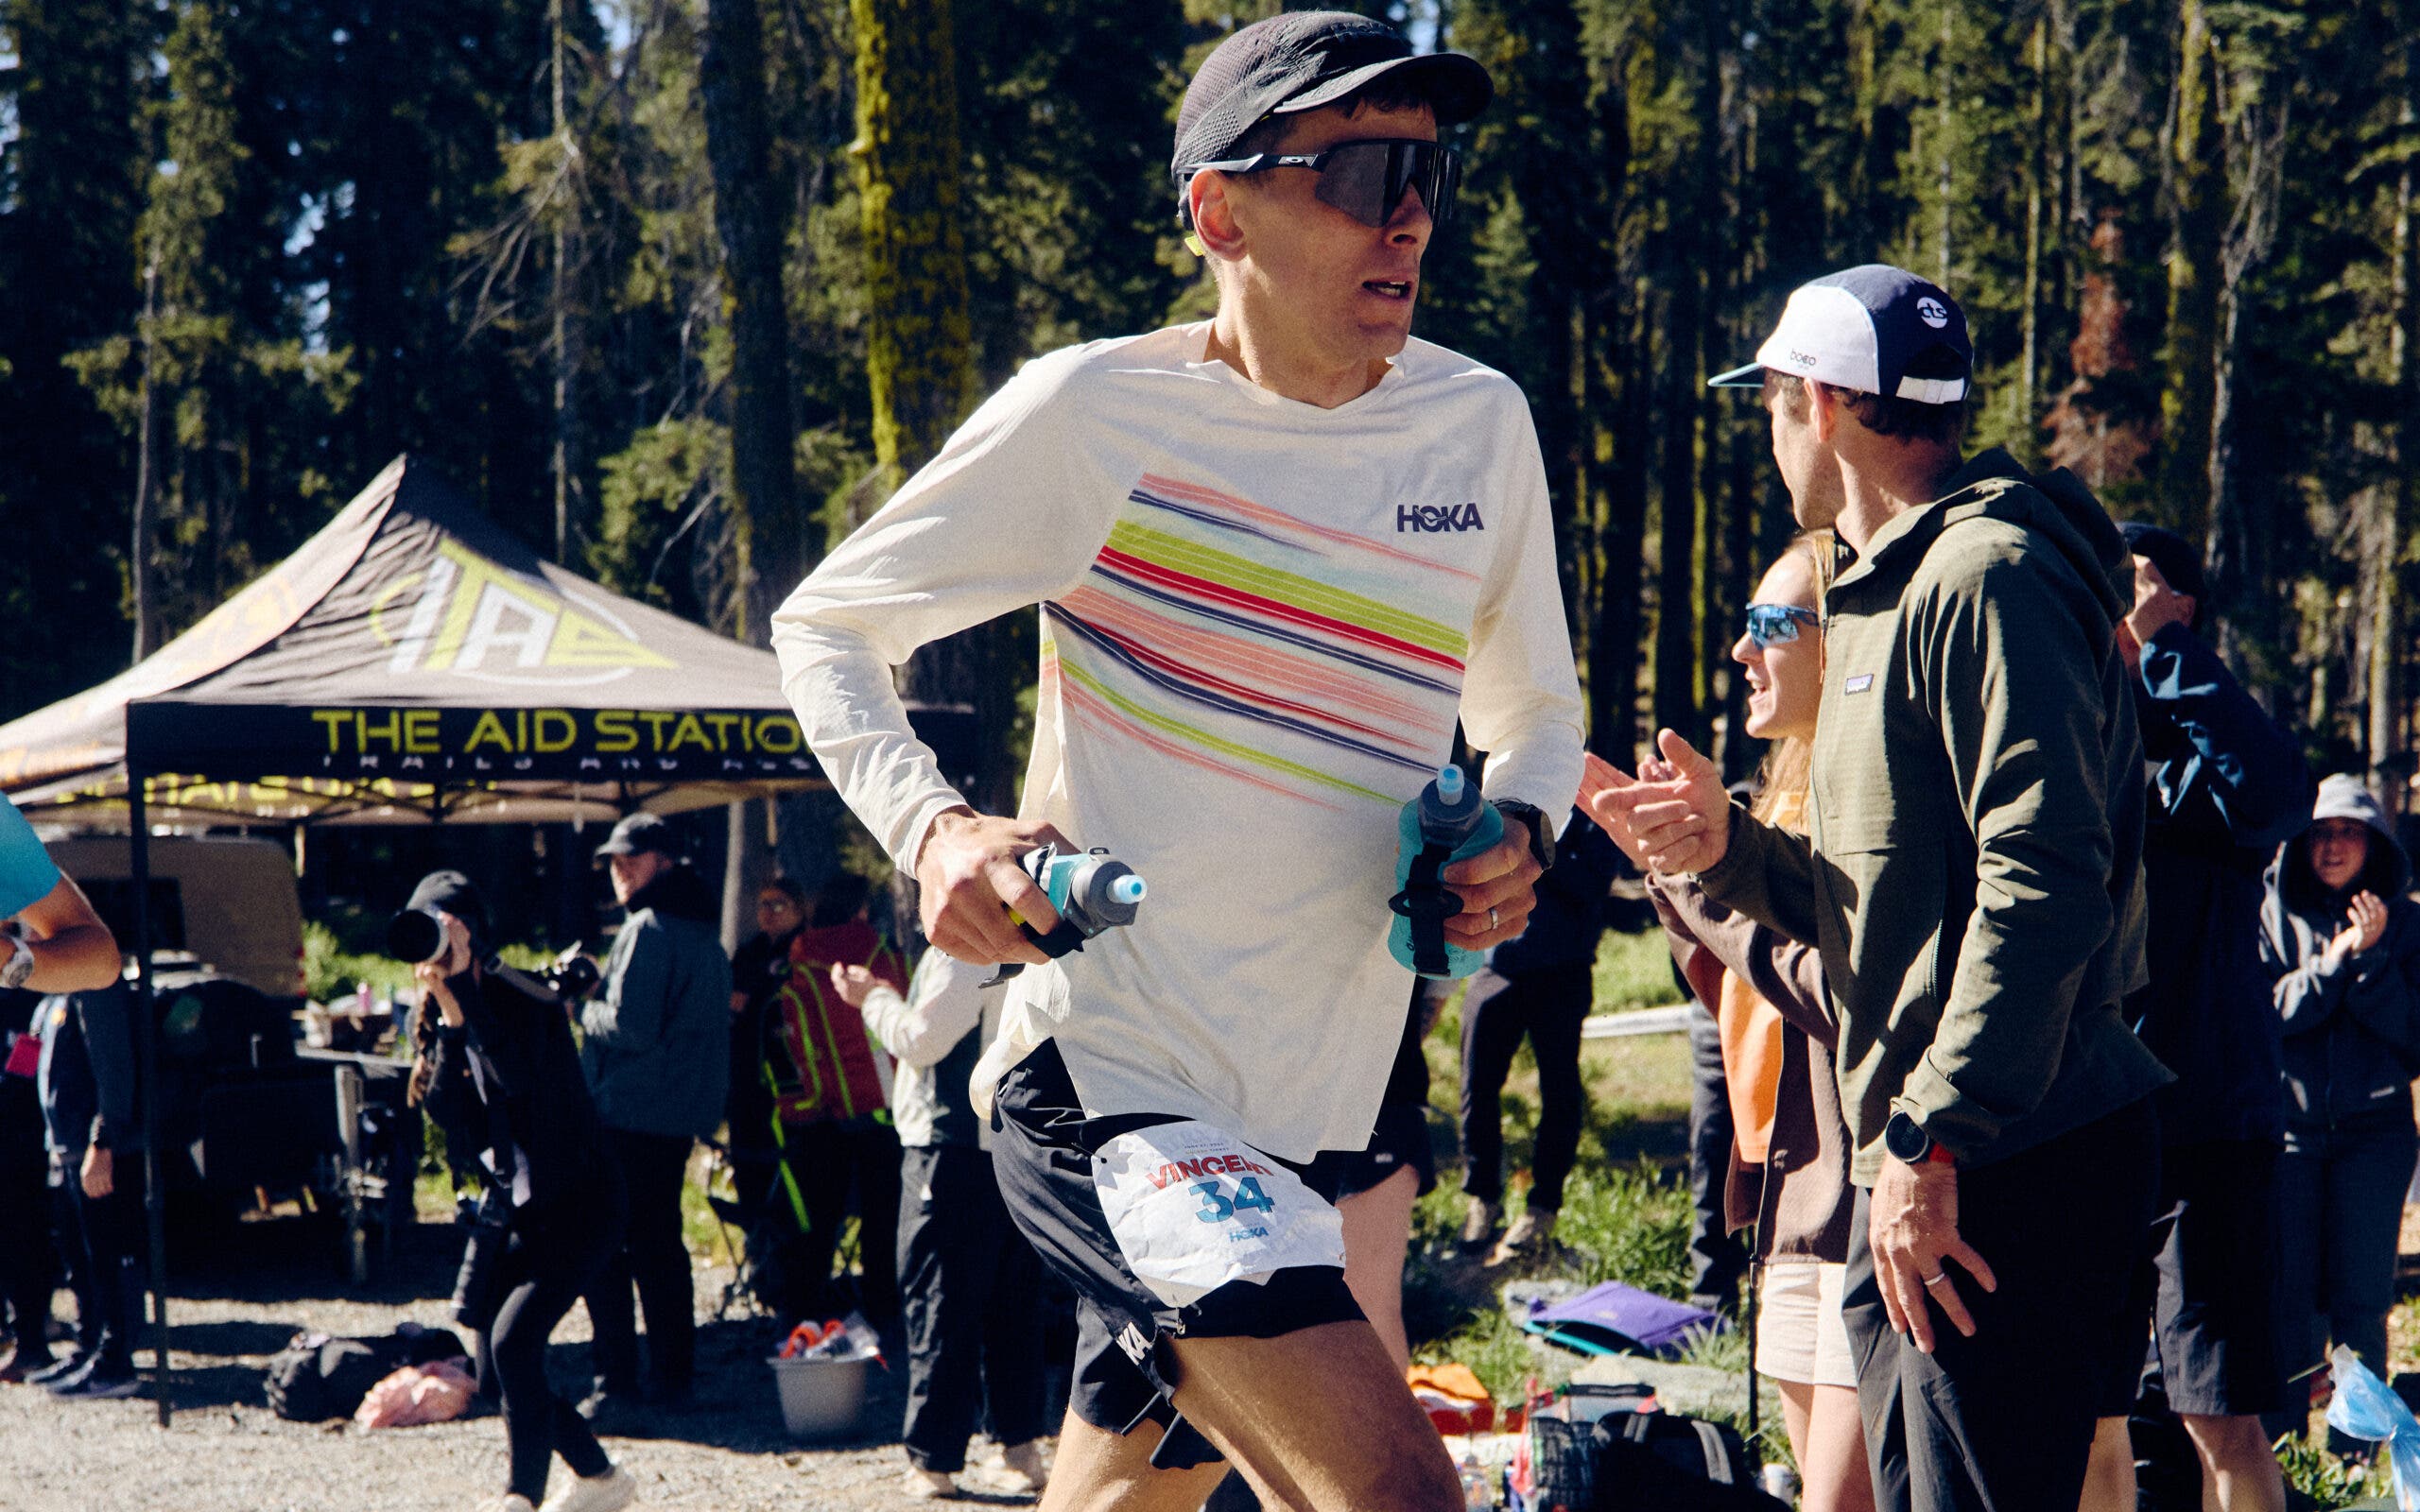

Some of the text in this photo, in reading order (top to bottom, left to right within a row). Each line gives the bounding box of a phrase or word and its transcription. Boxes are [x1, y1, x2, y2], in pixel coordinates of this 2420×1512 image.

[1396, 502, 1485, 533] HOKA
[311, 710, 813, 754] THE AID STATIO
[1188, 1177, 1275, 1222] 34
[1229, 1226, 1270, 1243] HOKA
